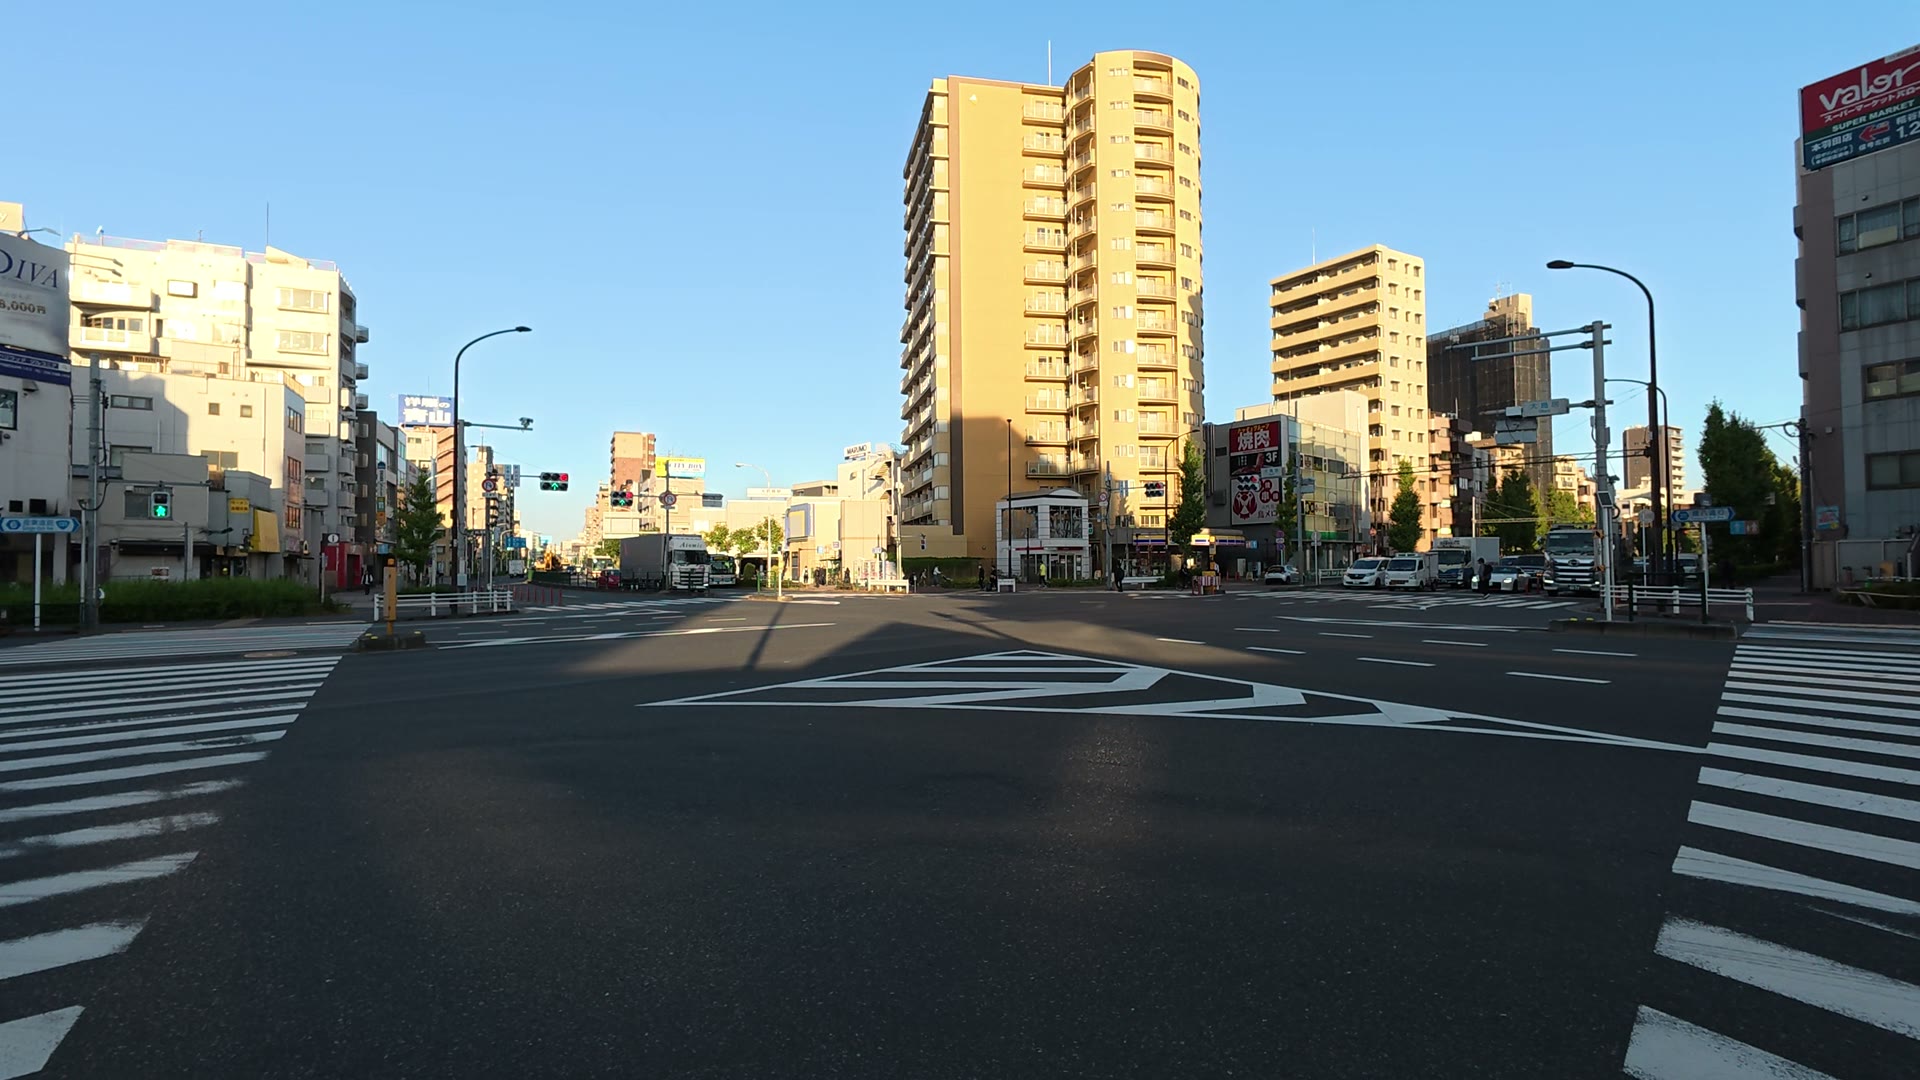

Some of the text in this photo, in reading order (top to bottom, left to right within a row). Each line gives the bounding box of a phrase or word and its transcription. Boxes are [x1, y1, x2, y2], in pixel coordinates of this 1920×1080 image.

[1832, 115, 1867, 132] SUPER
[1869, 99, 1915, 120] MARKET
[1811, 132, 1853, 152] 本羽田店
[403, 408, 451, 424] 青山
[1238, 429, 1270, 451] 焼肉
[1265, 452, 1278, 463] 3F
